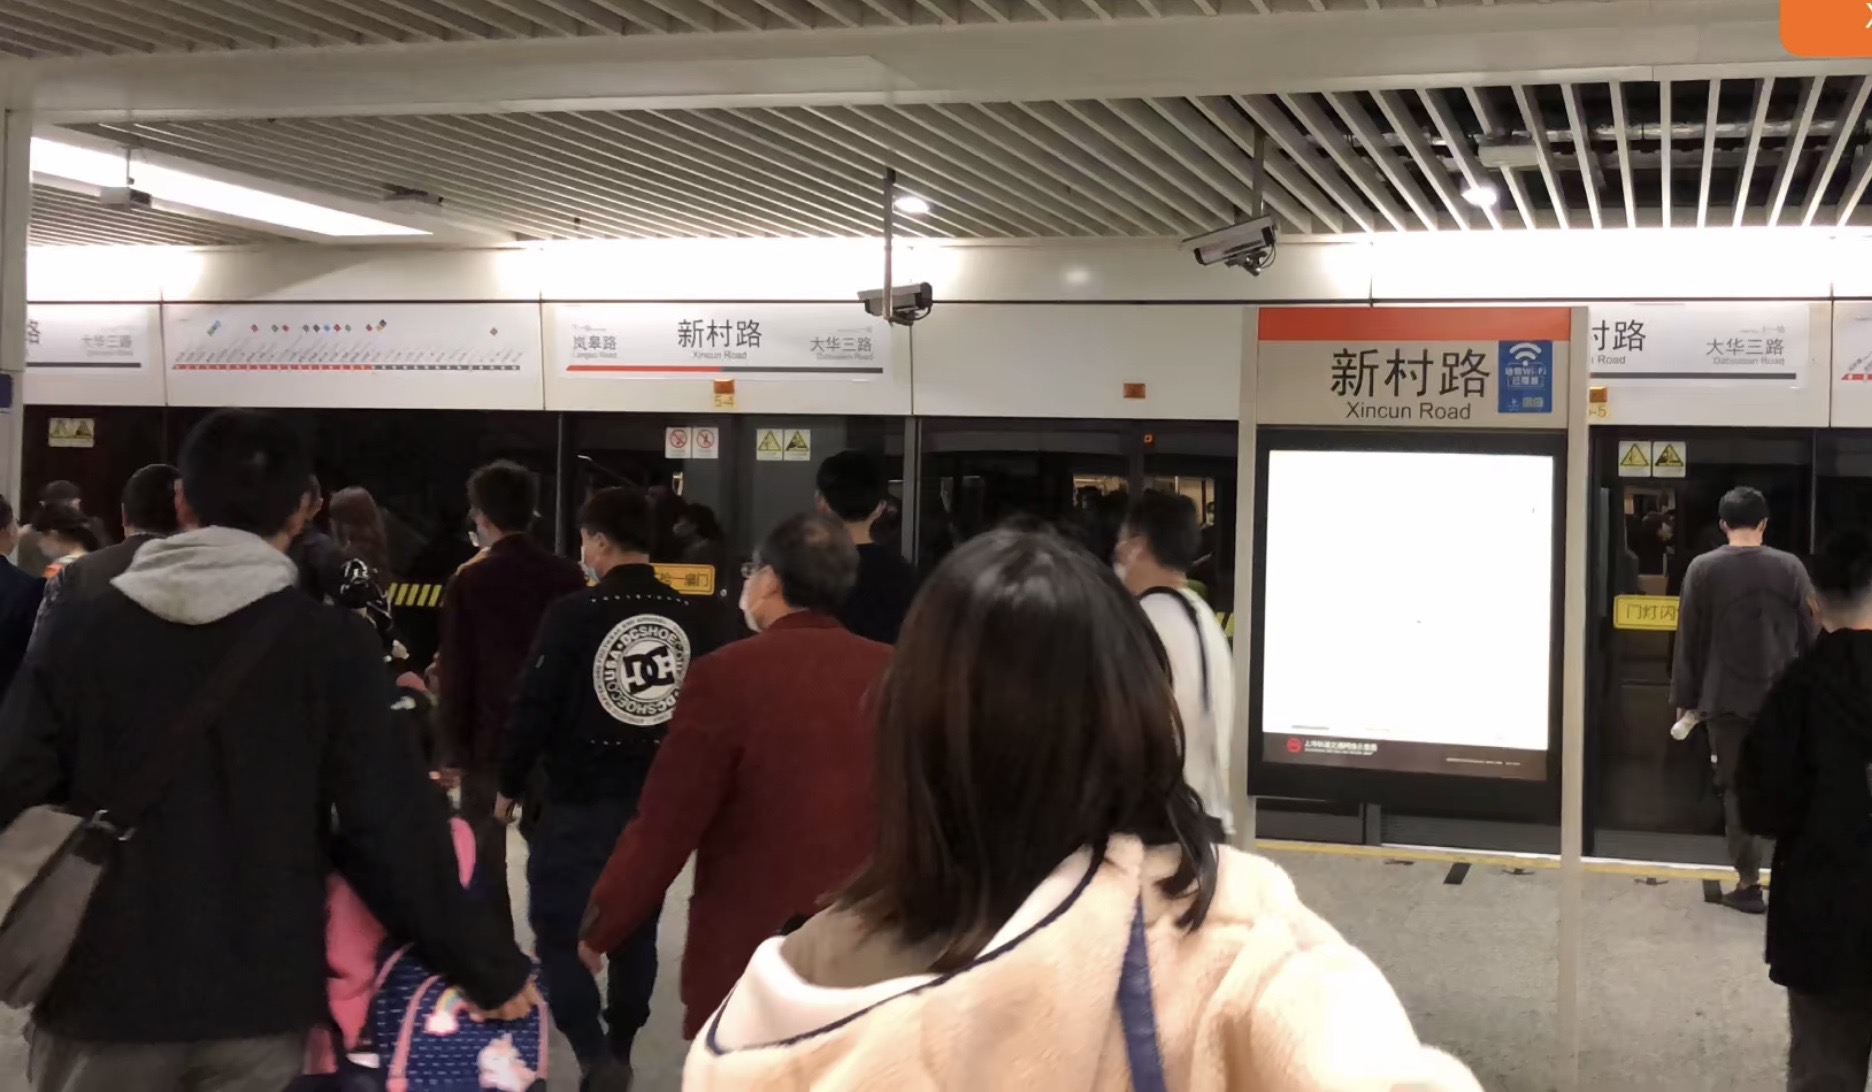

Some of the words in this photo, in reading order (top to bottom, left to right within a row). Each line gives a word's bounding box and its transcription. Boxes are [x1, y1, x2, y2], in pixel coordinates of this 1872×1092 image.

[678, 319, 763, 348] 新村路
[573, 335, 617, 350] 岚皋路
[809, 335, 872, 352] 大华三路
[1706, 338, 1784, 356] 大华三路
[724, 351, 747, 360] Road
[1597, 354, 1626, 365] Road
[1330, 348, 1490, 398] 新村路
[714, 395, 734, 407] 5-4
[1345, 402, 1412, 419] Xincun
[1419, 402, 1472, 420] Road
[1626, 603, 1679, 621] 门灯闪
